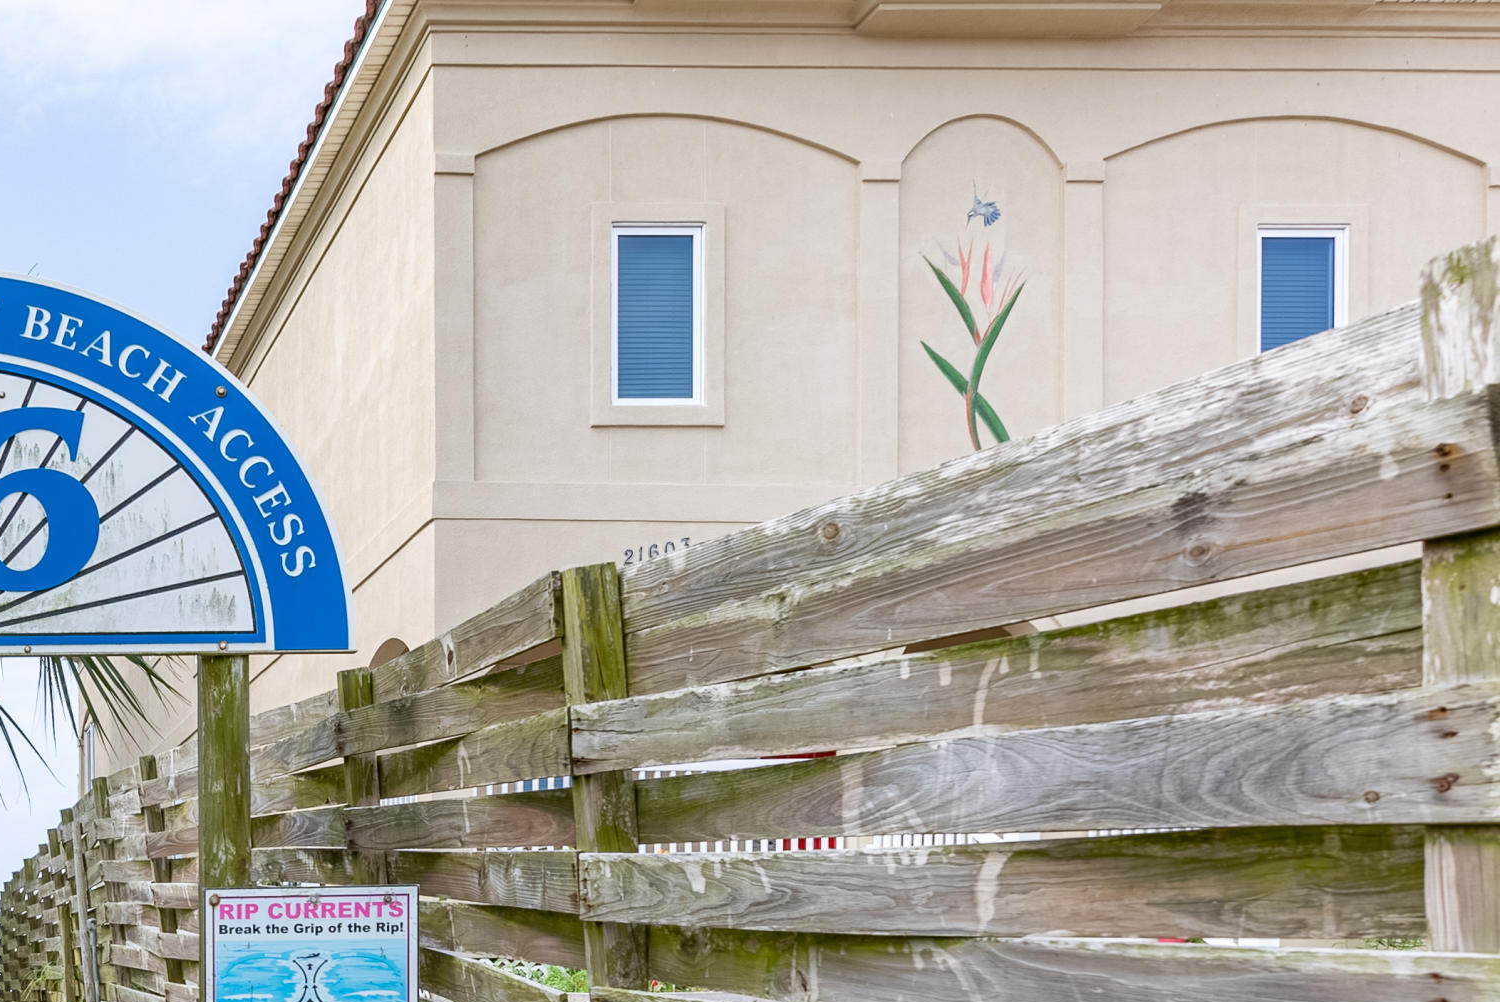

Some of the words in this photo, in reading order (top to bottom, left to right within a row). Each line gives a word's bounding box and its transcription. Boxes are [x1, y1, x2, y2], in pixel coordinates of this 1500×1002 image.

[25, 307, 188, 403] BEACH
[187, 404, 319, 579] ACCESS
[219, 903, 259, 920] RIP
[268, 901, 404, 919] CURRENTS
[219, 924, 261, 935] Break
[266, 924, 289, 934] the
[293, 923, 323, 936] Grip
[329, 923, 342, 933] of
[348, 923, 371, 933] the
[376, 922, 404, 934] Rip!
